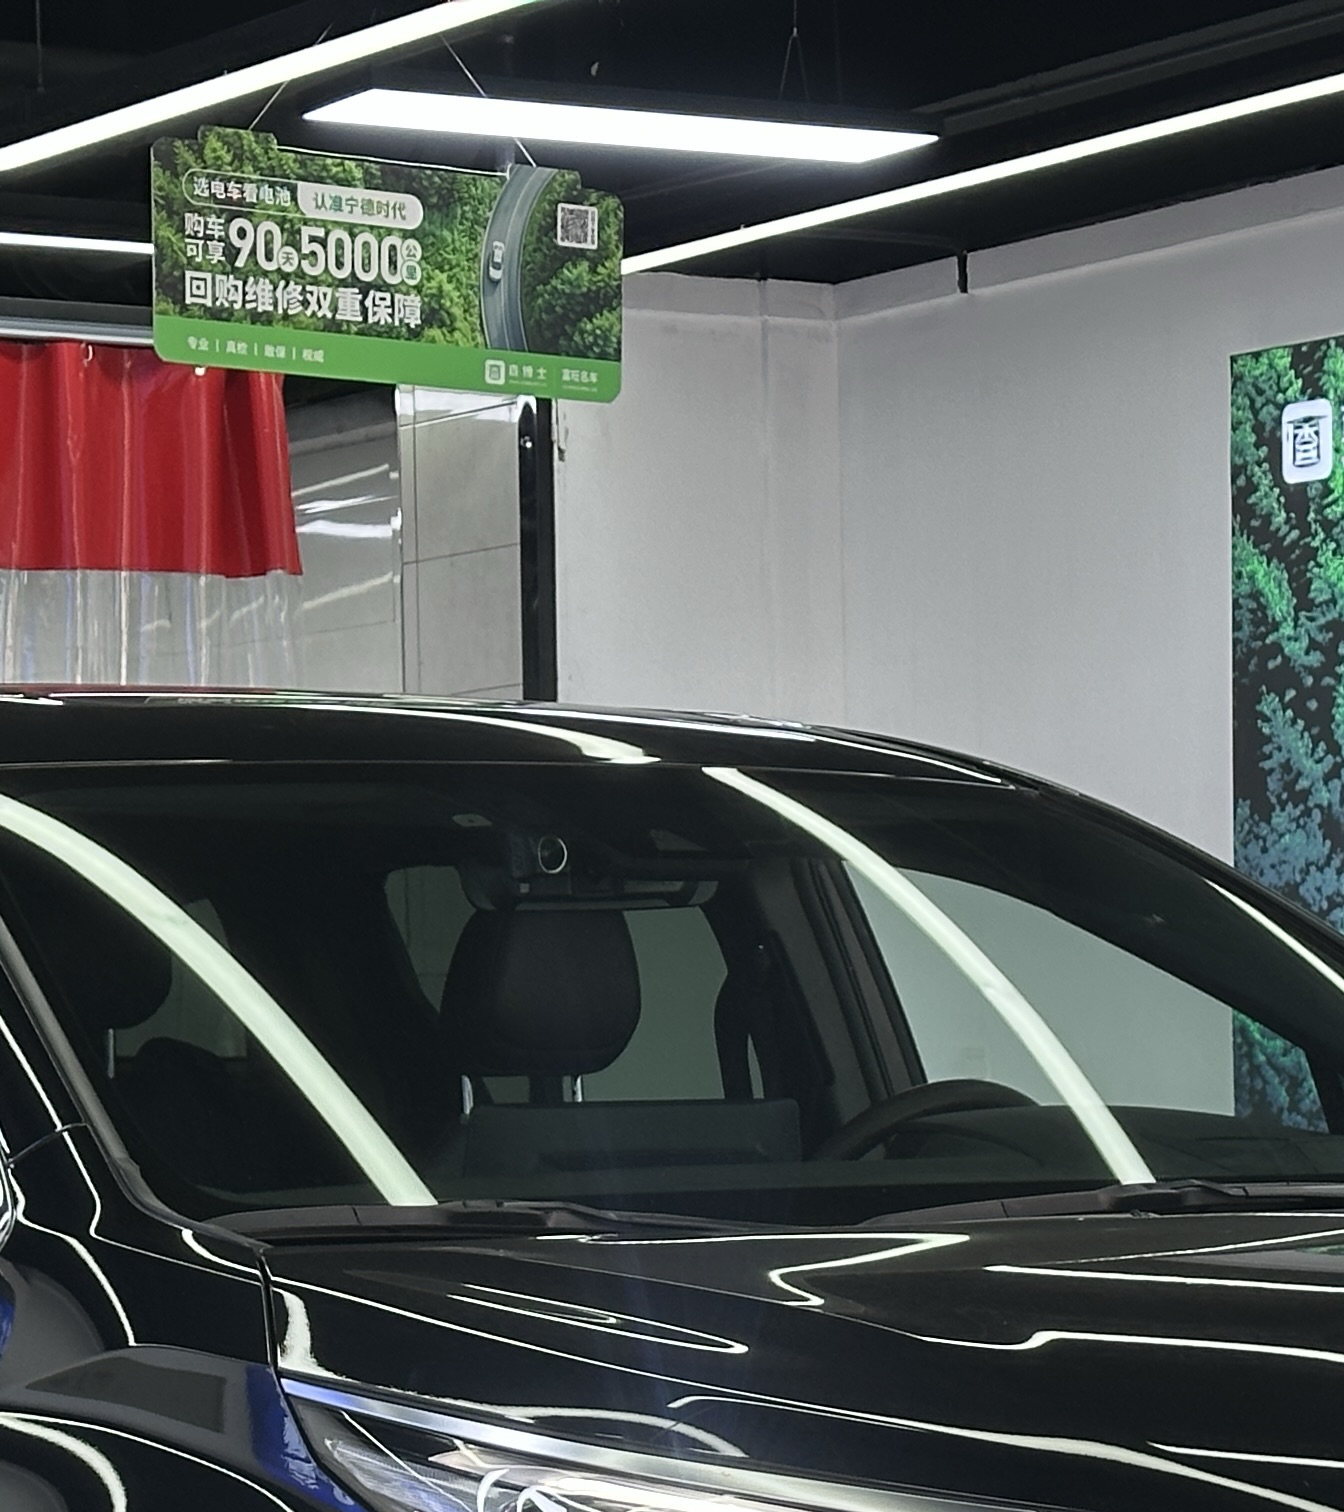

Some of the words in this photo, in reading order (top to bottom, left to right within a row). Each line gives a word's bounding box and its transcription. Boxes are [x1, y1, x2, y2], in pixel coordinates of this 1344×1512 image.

[193, 177, 291, 206] 选电车看电池
[313, 192, 406, 221] 认准宁德时代
[184, 213, 225, 239] 购车
[184, 238, 225, 264] 可享
[184, 270, 422, 328] 回购维修双重保障
